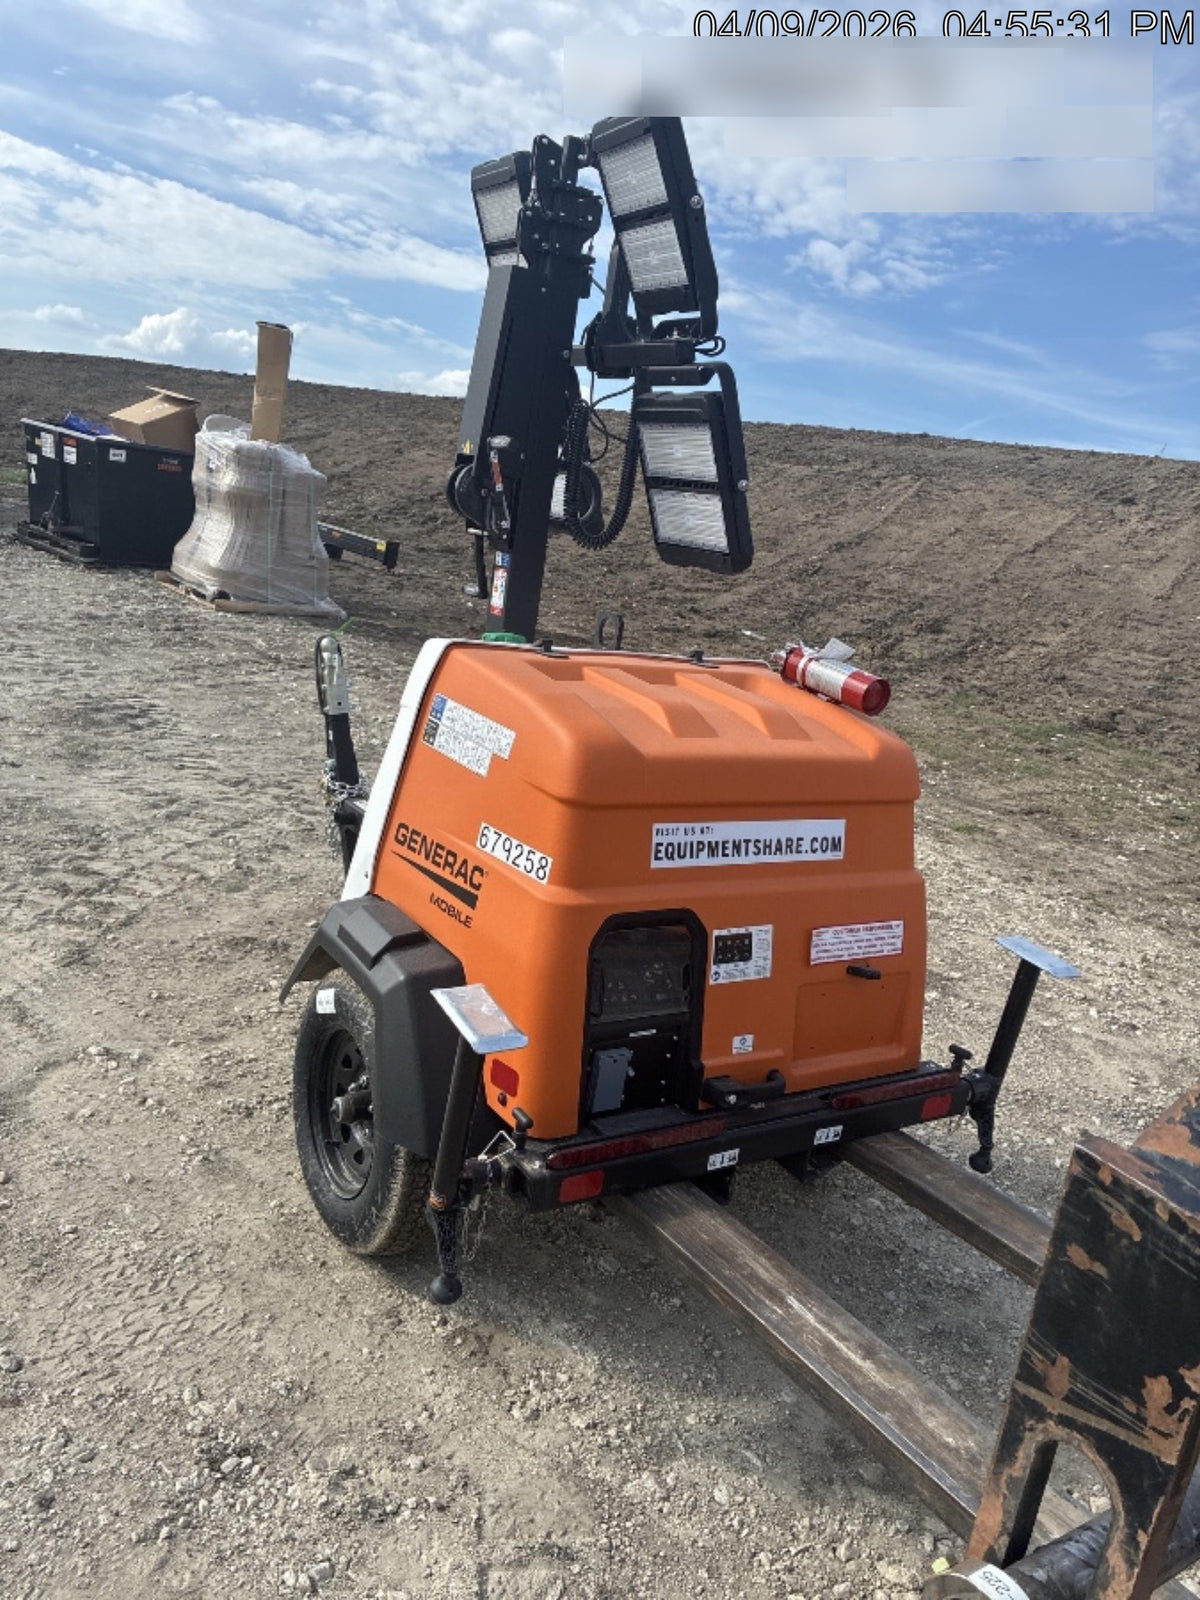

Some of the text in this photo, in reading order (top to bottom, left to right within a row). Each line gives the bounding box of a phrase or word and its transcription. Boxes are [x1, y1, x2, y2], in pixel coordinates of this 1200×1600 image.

[653, 835, 843, 861] EQUIPMENTSHARE.COM
[655, 826, 680, 837] VISIT
[684, 826, 696, 836] US
[394, 822, 485, 892] GENERAC
[479, 826, 550, 881] 679258
[429, 892, 474, 929] MOBILE
